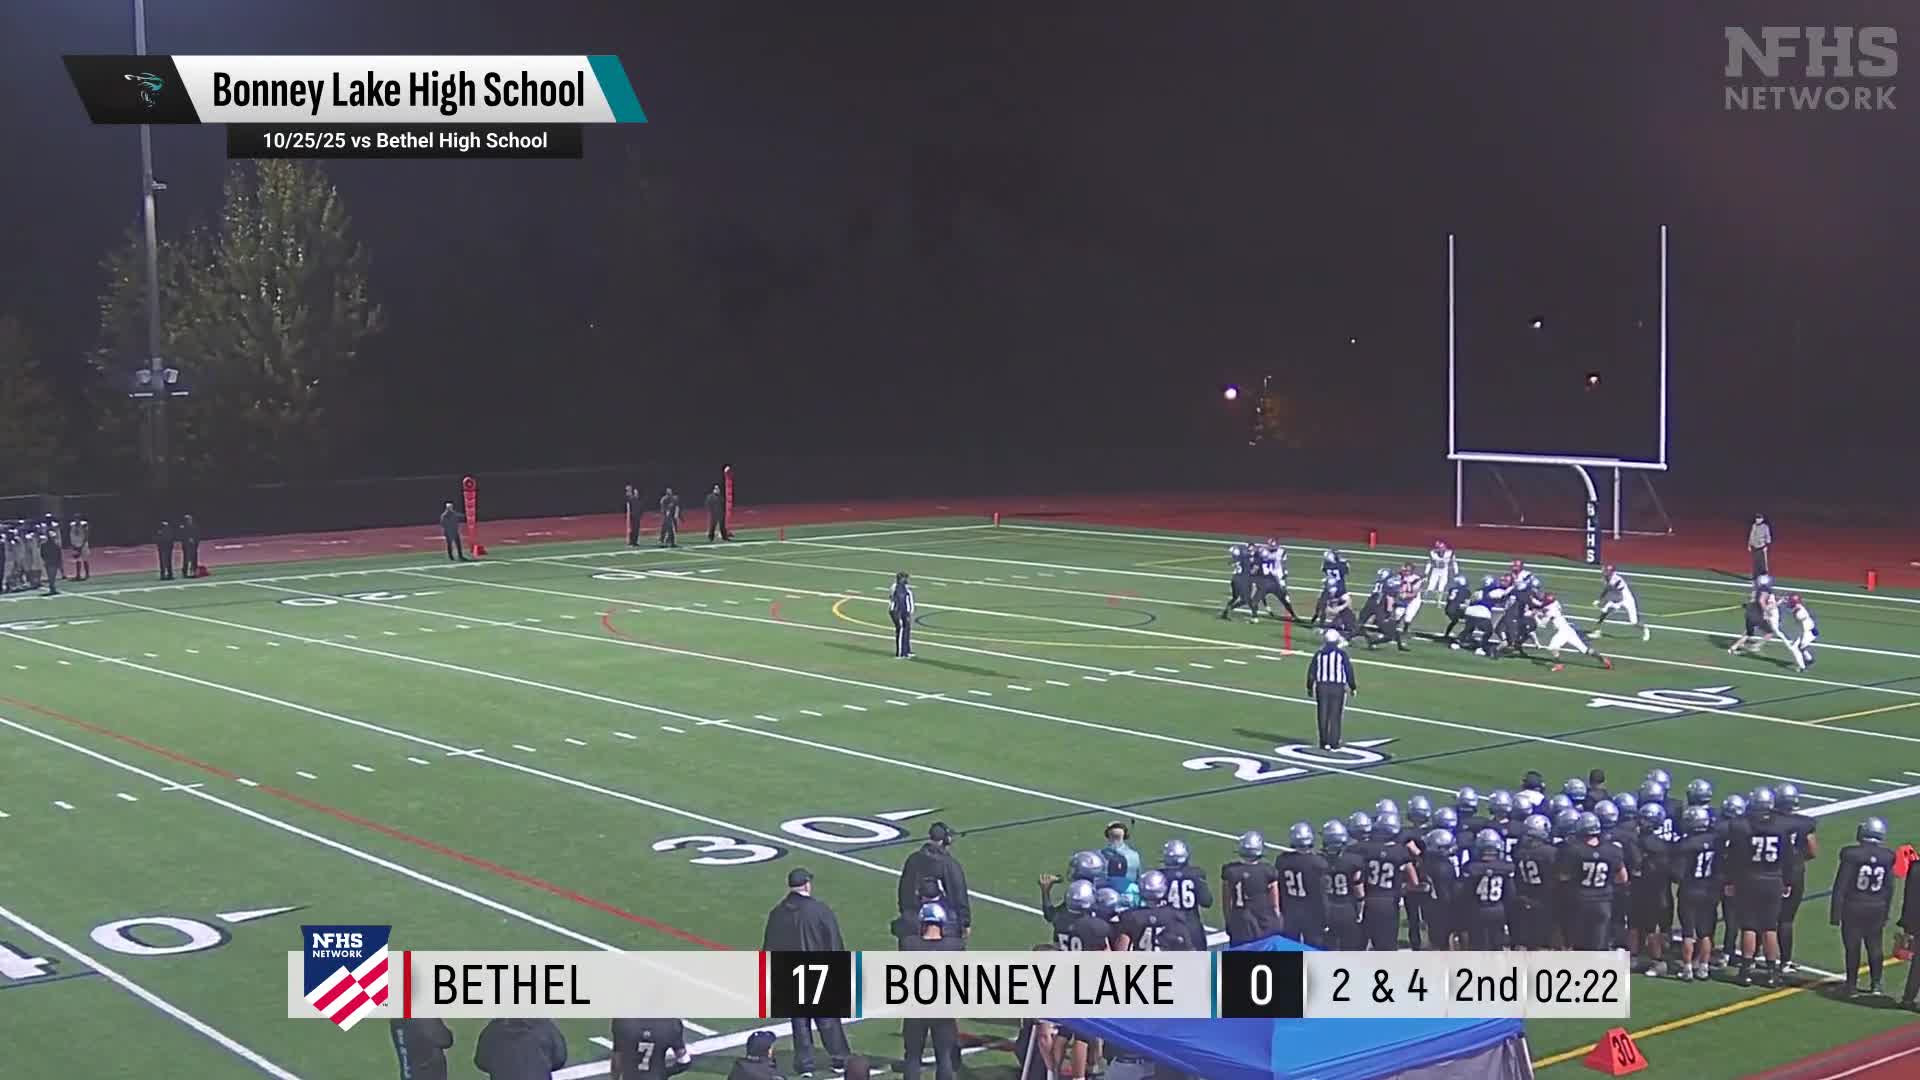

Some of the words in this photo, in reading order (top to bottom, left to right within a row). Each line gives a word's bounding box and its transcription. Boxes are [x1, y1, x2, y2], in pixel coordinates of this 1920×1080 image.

[1586, 502, 1597, 563] BLHS
[1585, 688, 1740, 714] 10
[1182, 743, 1386, 782] 20
[651, 815, 902, 866] 30
[1751, 835, 1779, 862] 75
[1368, 859, 1395, 889] 32
[1518, 859, 1542, 885] 12
[1581, 861, 1609, 888] 76
[1694, 851, 1714, 878] 17
[1856, 864, 1886, 892] 63
[1167, 878, 1195, 910] 46
[1284, 869, 1307, 897] 21
[1476, 875, 1504, 902] 48
[638, 1042, 655, 1070] 7
[1612, 1033, 1636, 1067] 30
